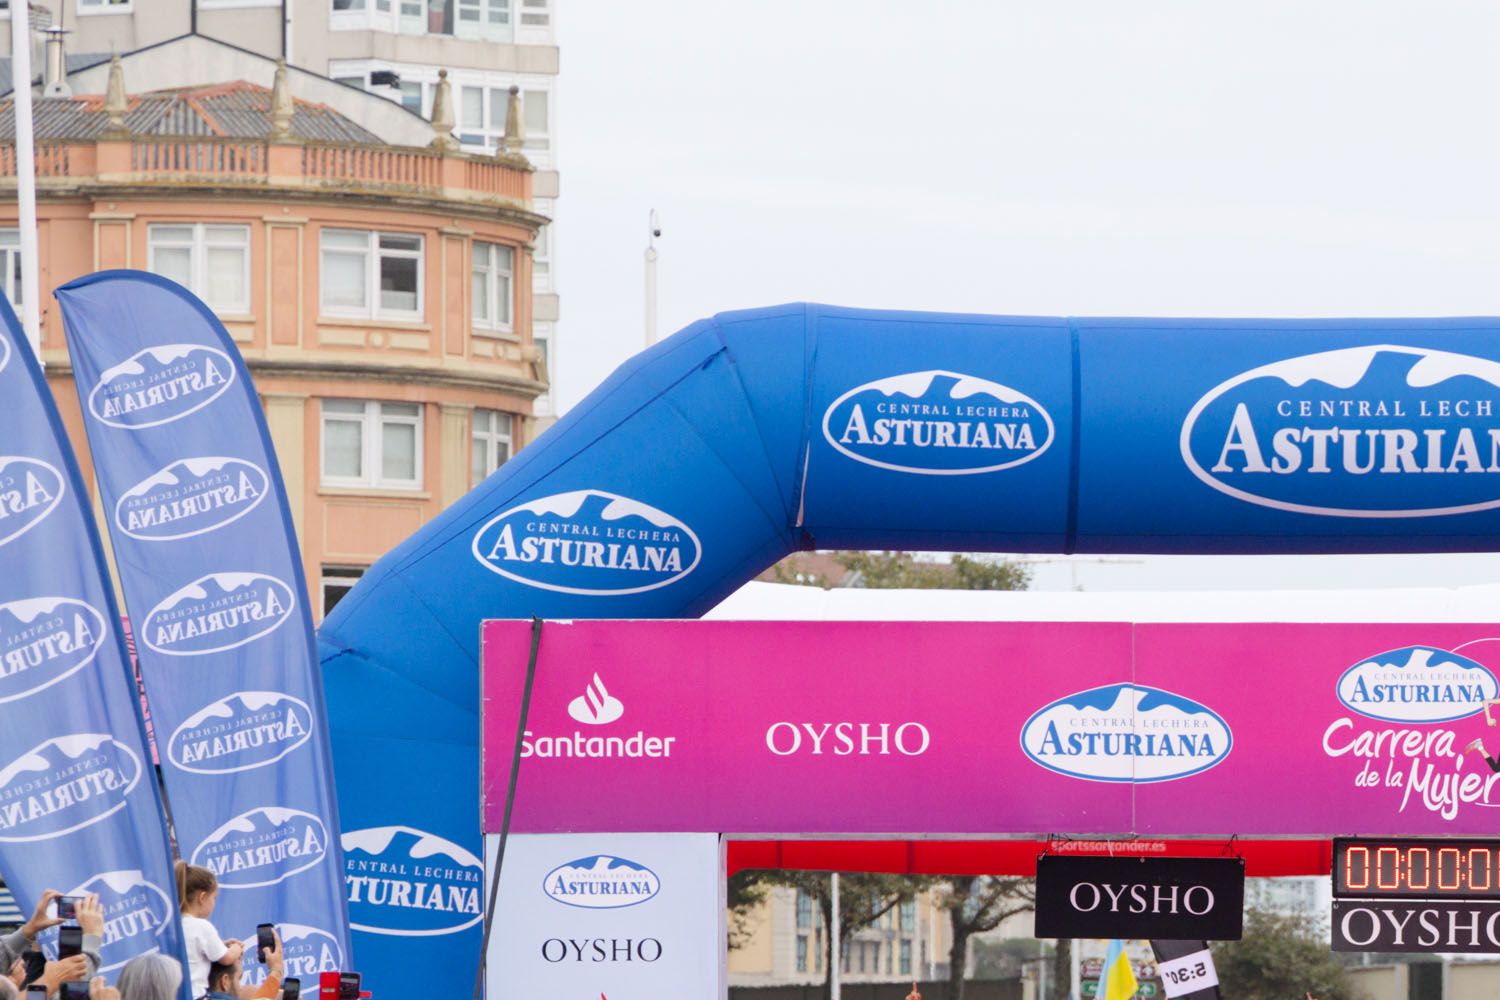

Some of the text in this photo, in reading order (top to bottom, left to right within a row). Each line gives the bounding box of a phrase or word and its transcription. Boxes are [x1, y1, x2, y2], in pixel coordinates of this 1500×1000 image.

[876, 402, 1030, 419] CENTRAL LECHERA
[1276, 399, 1406, 418] CENTRAL
[840, 403, 1037, 450] ASTURIANA
[526, 521, 680, 543] CENTRAL LECHERA
[487, 522, 683, 573] ASTURIANA
[1349, 673, 1486, 704] ASTURIANA
[1374, 672, 1482, 681] CENTRAL LECHERA
[1070, 717, 1209, 729] CENTRAL LECHERA
[520, 729, 675, 759] Santander
[765, 721, 930, 756] OYSHO
[1038, 719, 1215, 757] ASTURIANA
[1322, 717, 1456, 759] Carrera
[1355, 766, 1382, 788] de
[1385, 762, 1404, 788] la
[347, 859, 479, 883] ENTRAL LECHERA
[552, 874, 652, 895] ASTURIANA
[345, 875, 480, 915] TURIANA
[1069, 882, 1215, 916] OYSHO
[541, 938, 663, 963] OYSHO
